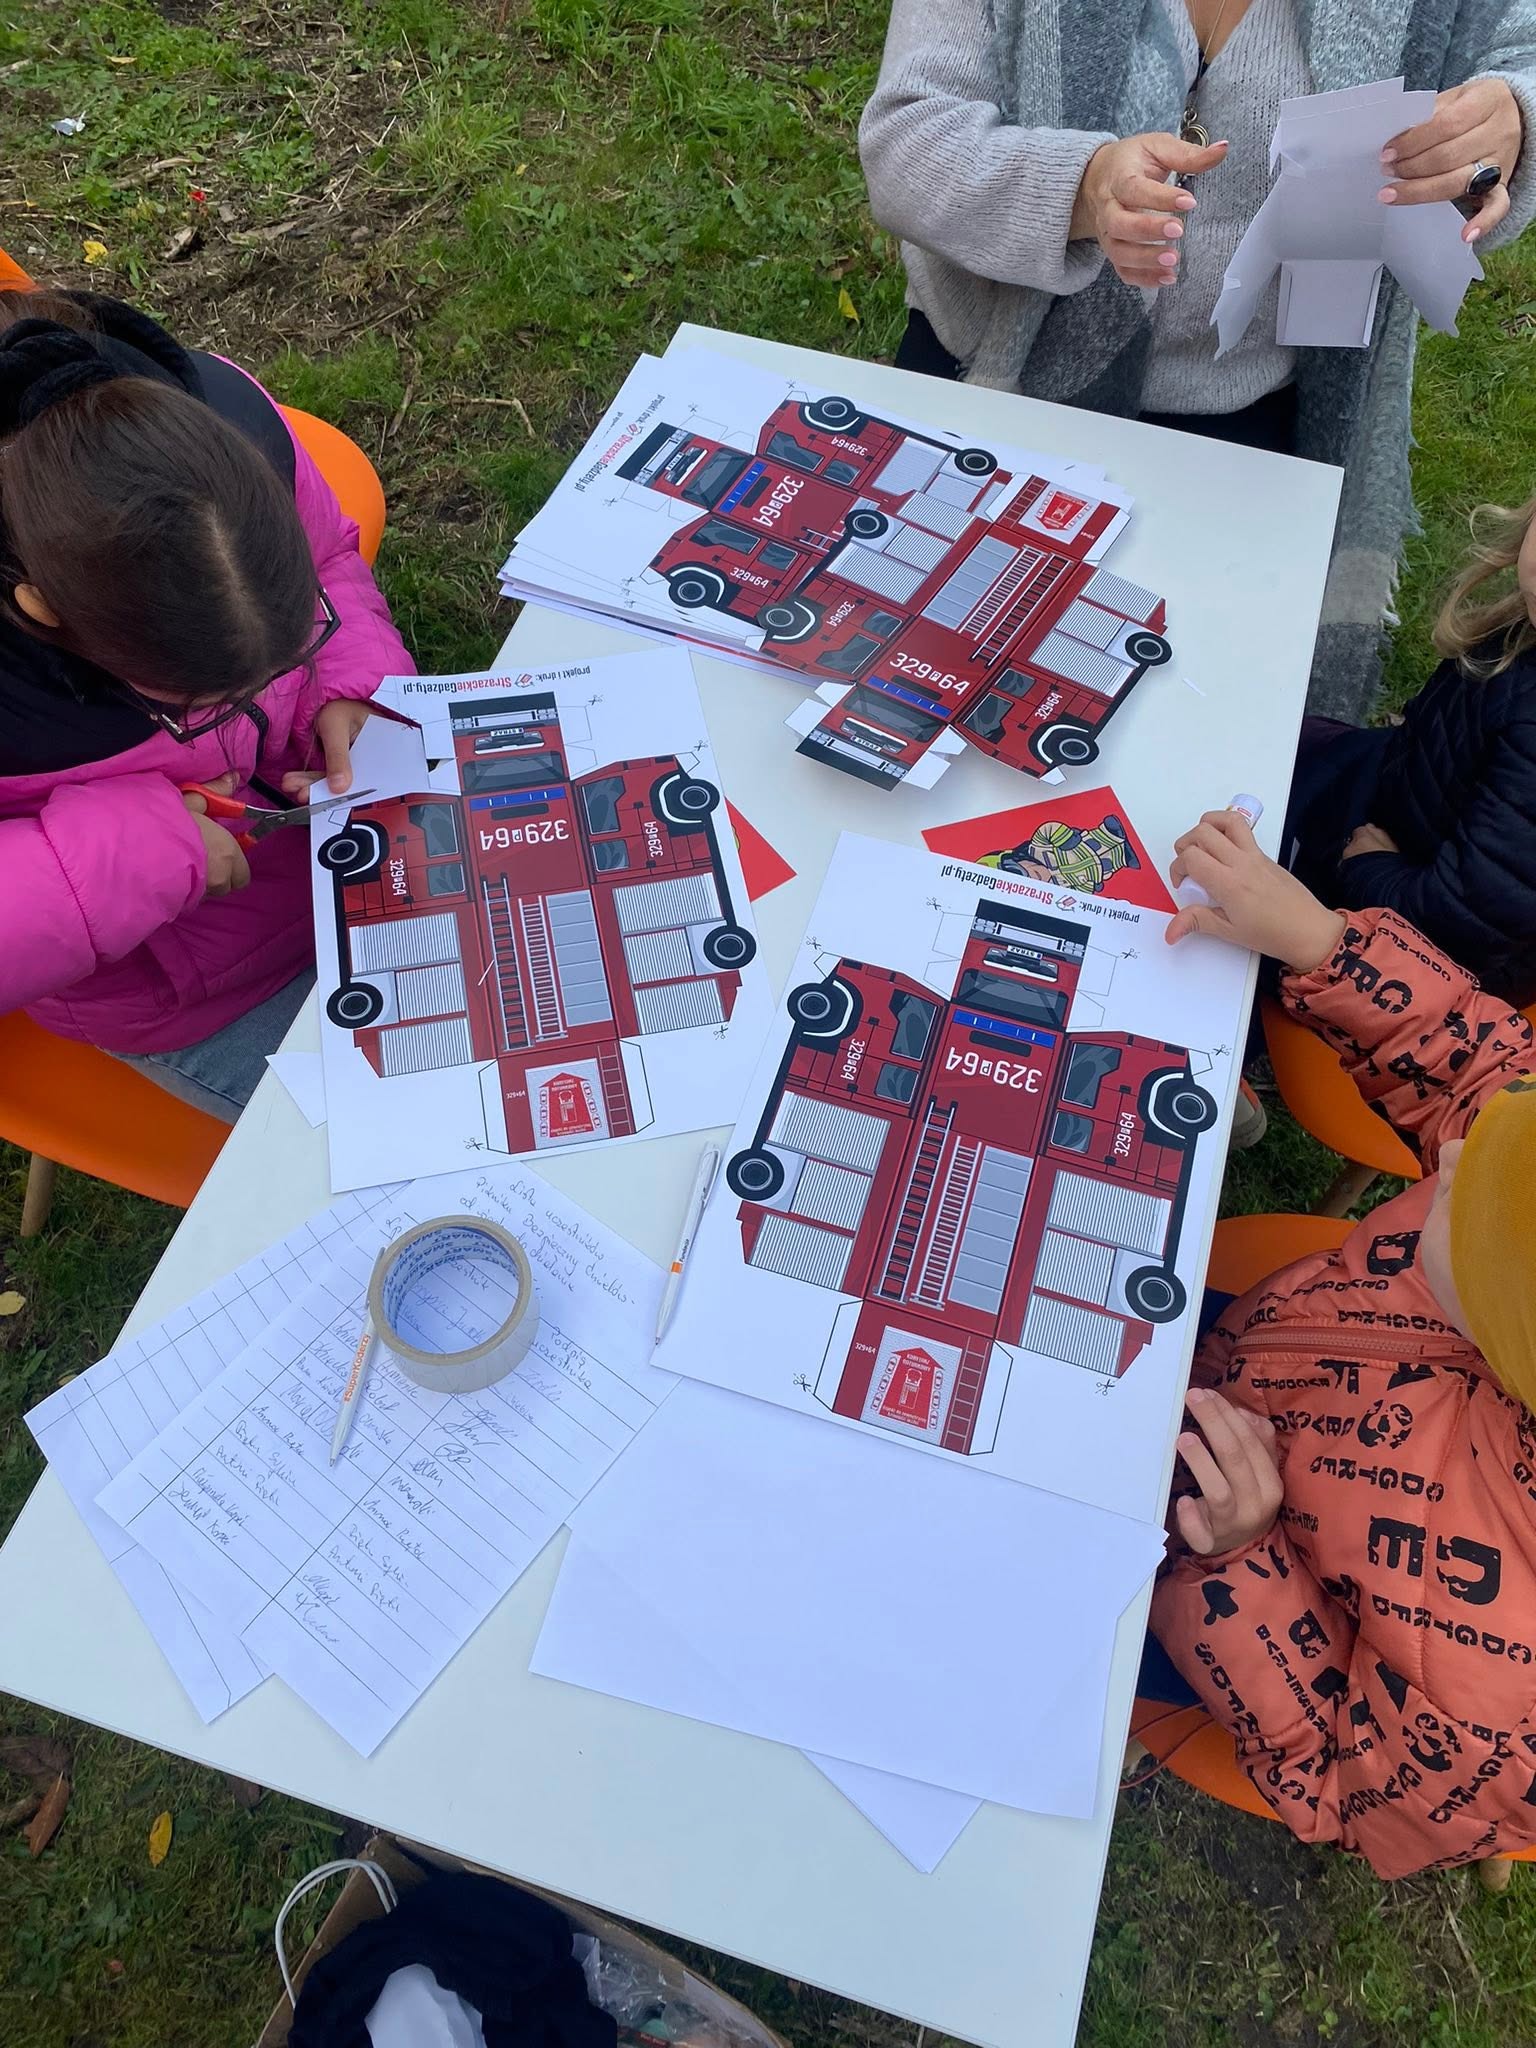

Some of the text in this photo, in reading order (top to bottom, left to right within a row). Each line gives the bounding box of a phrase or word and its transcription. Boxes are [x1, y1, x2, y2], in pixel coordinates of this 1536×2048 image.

[535, 672, 557, 683] druk:
[563, 665, 591, 679] projekt
[403, 676, 512, 695] StrazackieGadzety.pl
[941, 864, 1054, 905] StrazackieGadzety.pl
[1079, 899, 1102, 914] druk:
[1109, 908, 1141, 924] projekt
[509, 1179, 537, 1207] Lista
